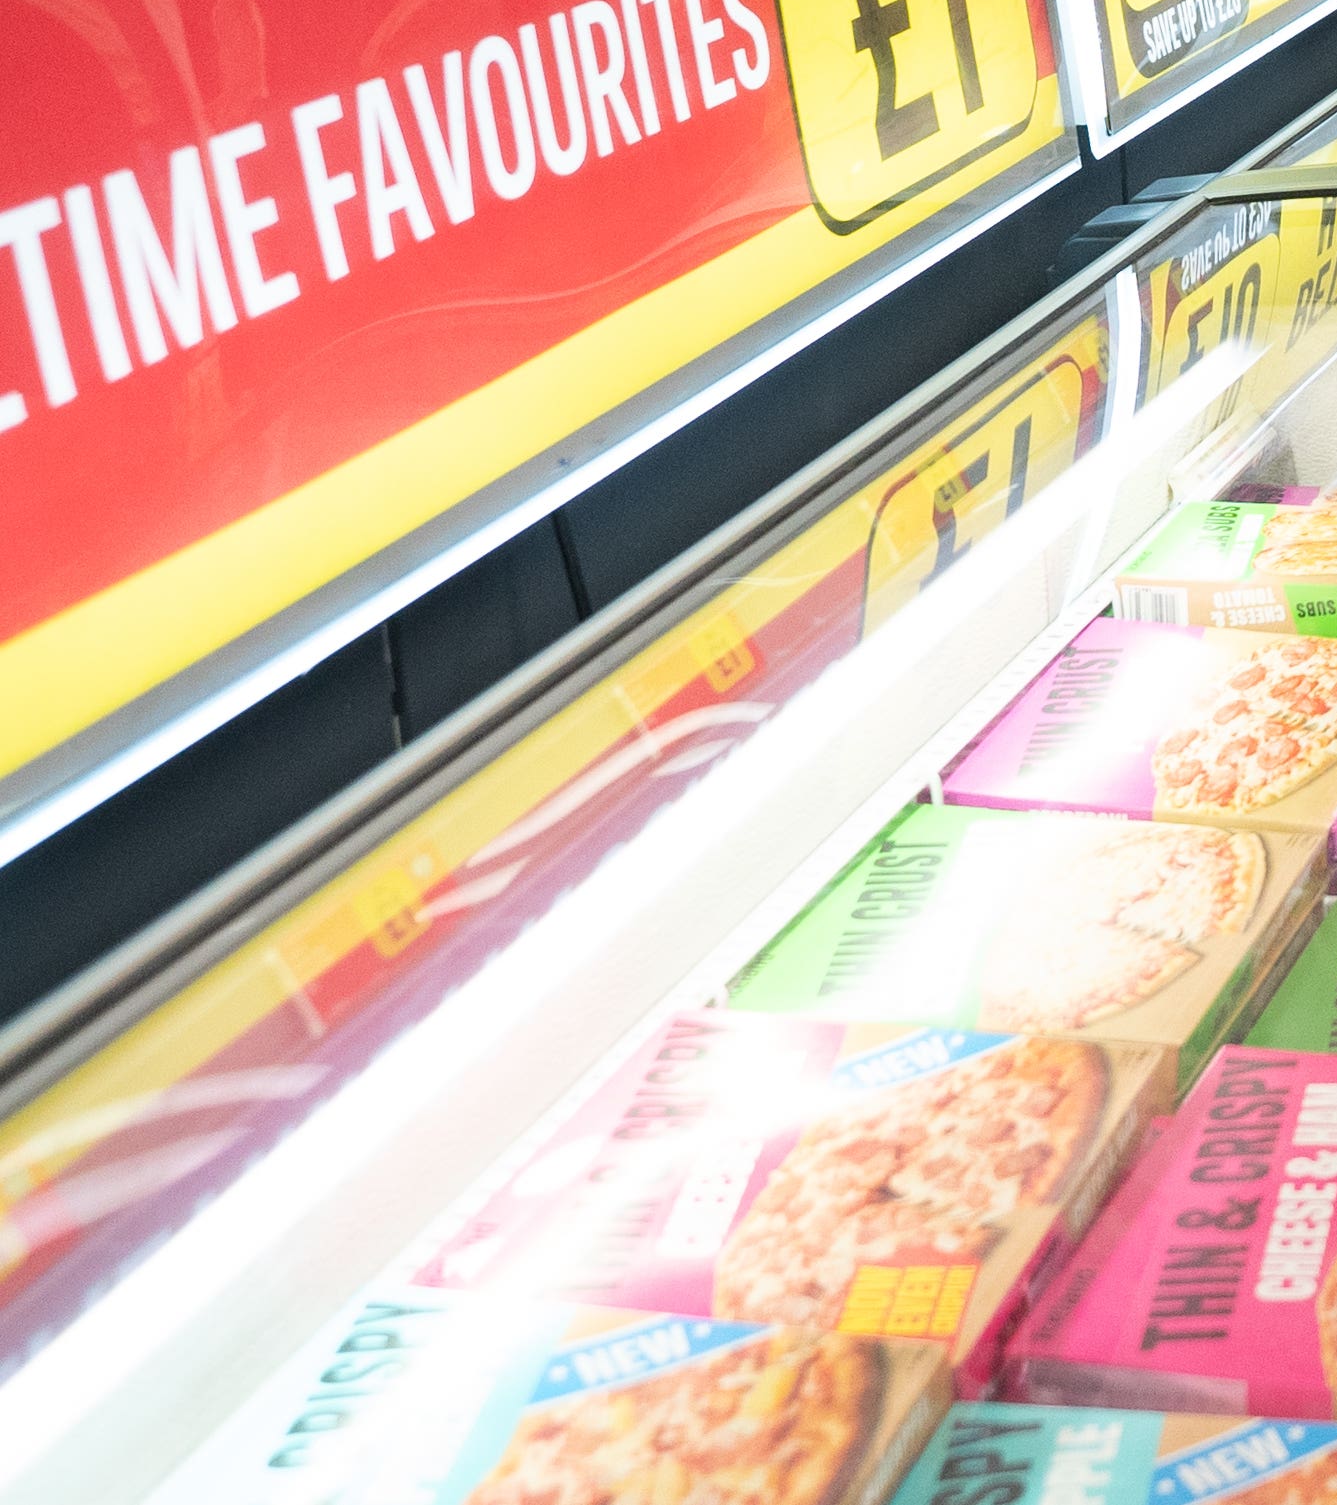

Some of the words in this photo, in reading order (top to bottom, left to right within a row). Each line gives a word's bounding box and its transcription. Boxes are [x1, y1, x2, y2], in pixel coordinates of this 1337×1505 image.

[1142, 6, 1180, 65] SAVE
[1177, 0, 1199, 47] UP
[0, 122, 300, 436] TIME
[1212, 586, 1278, 608] TOMATO
[1227, 604, 1286, 627] CHEESE
[1296, 597, 1336, 618] SUBS
[1041, 646, 1124, 715] CRUST
[851, 840, 949, 920] CRUST
[852, 1034, 951, 1084] NEW
[1189, 1057, 1298, 1184] CRISPY
[1175, 1195, 1266, 1231] &
[1139, 1244, 1250, 1353] THIN
[574, 1322, 690, 1383] NEW
[1176, 1425, 1292, 1496] NEW
